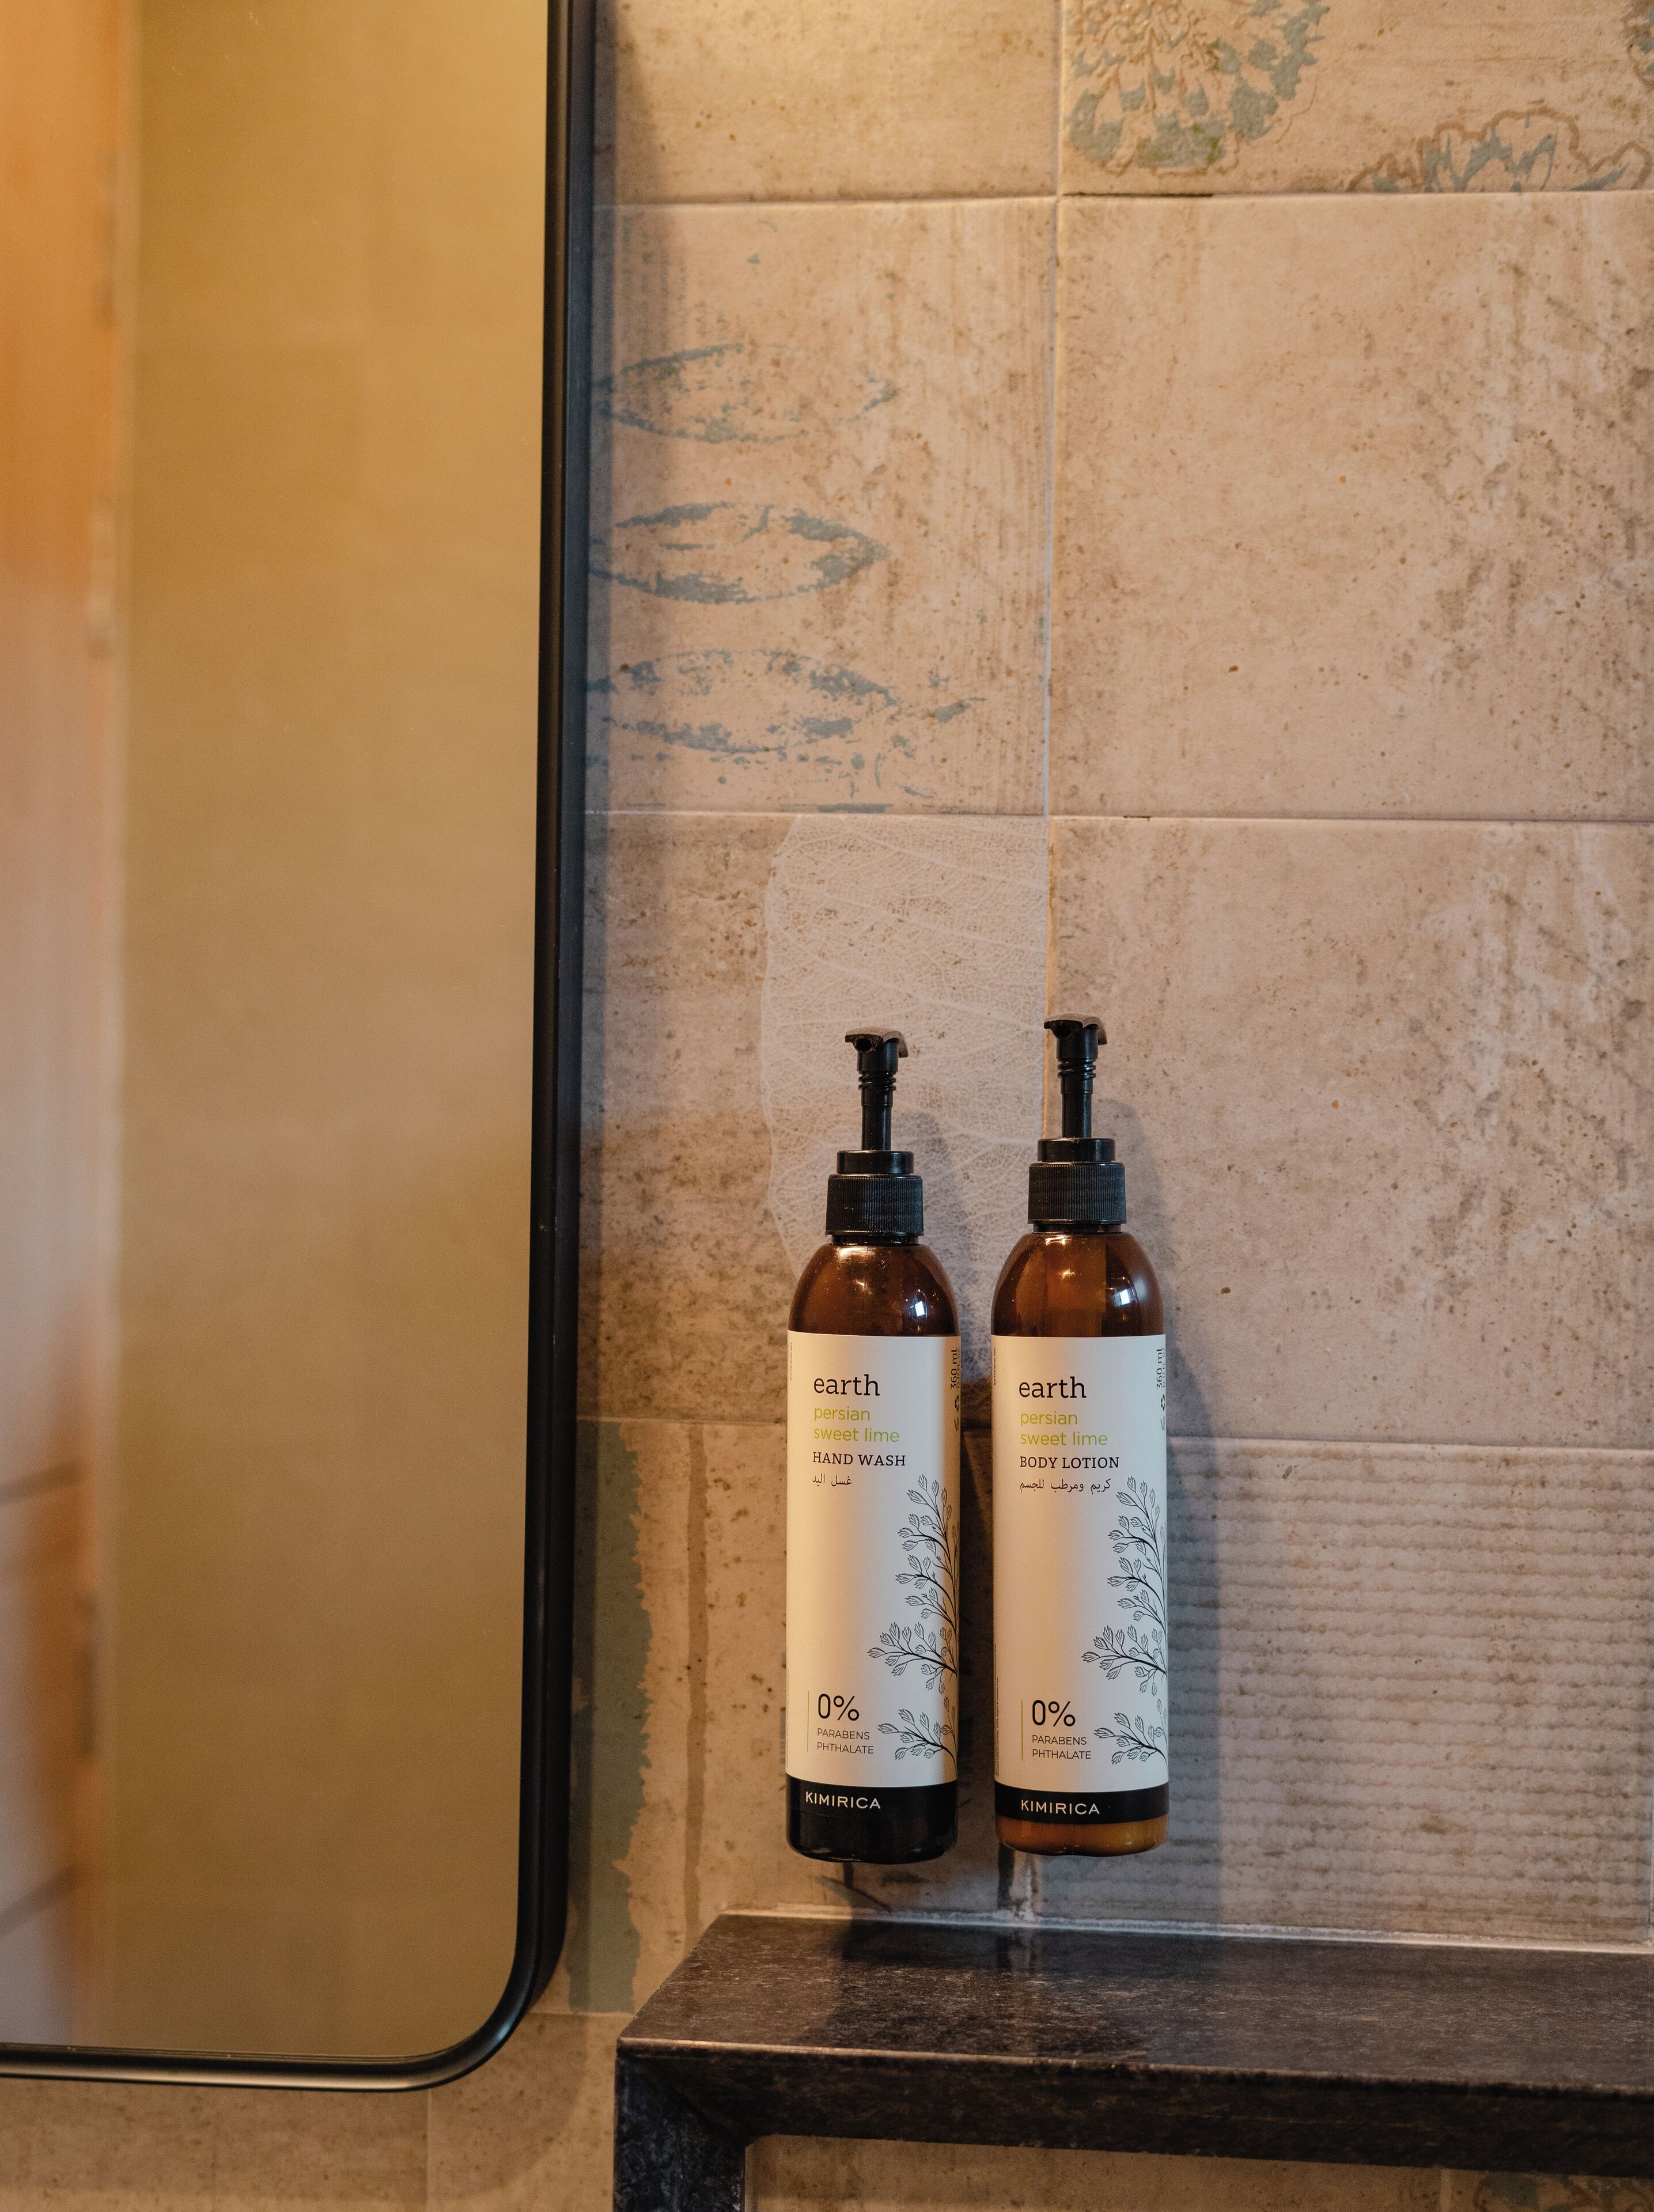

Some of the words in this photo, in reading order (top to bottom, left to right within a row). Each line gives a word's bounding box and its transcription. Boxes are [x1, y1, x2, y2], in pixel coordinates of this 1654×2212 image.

[813, 1374, 880, 1396] earth
[1019, 1376, 1087, 1399] earth
[814, 1407, 870, 1421] persian
[1020, 1411, 1078, 1426] persian
[813, 1427, 858, 1441] sweet
[865, 1427, 899, 1442] lime
[1020, 1433, 1066, 1446] sweet
[1073, 1431, 1107, 1446] lime
[812, 1452, 853, 1465] HAND
[858, 1454, 906, 1466] WASH
[1020, 1456, 1058, 1468] BODY
[1062, 1457, 1119, 1469] LOTION
[812, 1474, 825, 1486] اليد
[831, 1475, 852, 1487] غسل
[1020, 1479, 1044, 1493] للجسم
[1050, 1479, 1084, 1493] ومرطب
[1091, 1478, 1111, 1495] كريم
[817, 1694, 860, 1721] 0%
[1032, 1699, 1076, 1727] 0%
[817, 1728, 870, 1740] PARABENS
[1032, 1734, 1087, 1745] PARABENS
[817, 1742, 874, 1754] PHTHALATE
[1032, 1748, 1091, 1759] PHTHALATE
[805, 1791, 881, 1809] KIMIRICA
[1021, 1799, 1100, 1815] KIMIRICA
